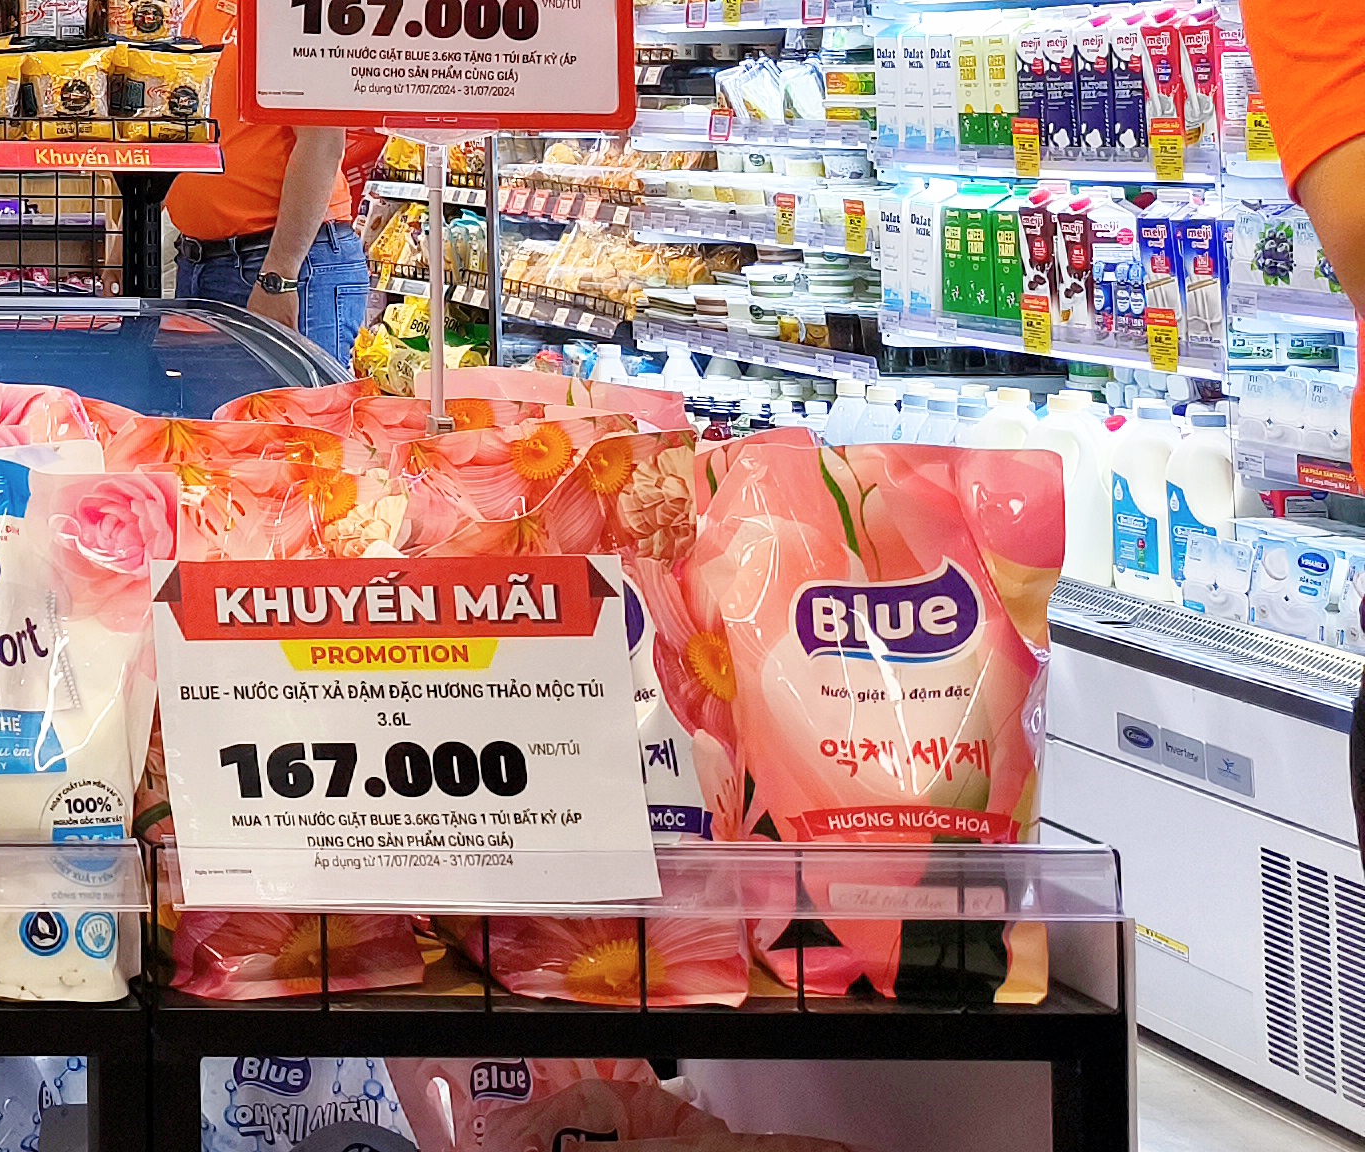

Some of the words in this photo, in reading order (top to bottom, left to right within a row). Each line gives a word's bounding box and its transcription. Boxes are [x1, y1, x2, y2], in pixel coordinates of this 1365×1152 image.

[214, 572, 437, 626] KHUYẾN
[453, 574, 557, 622] MÃI
[813, 595, 958, 642] Blue
[310, 645, 469, 665] PROMOTION
[377, 711, 411, 727] 3.6L
[220, 741, 528, 800] 167.000
[828, 811, 894, 829] HƯƠNG
[899, 810, 950, 828] NƯỚC
[956, 817, 990, 834] HOA
[474, 1066, 527, 1093] Blue
